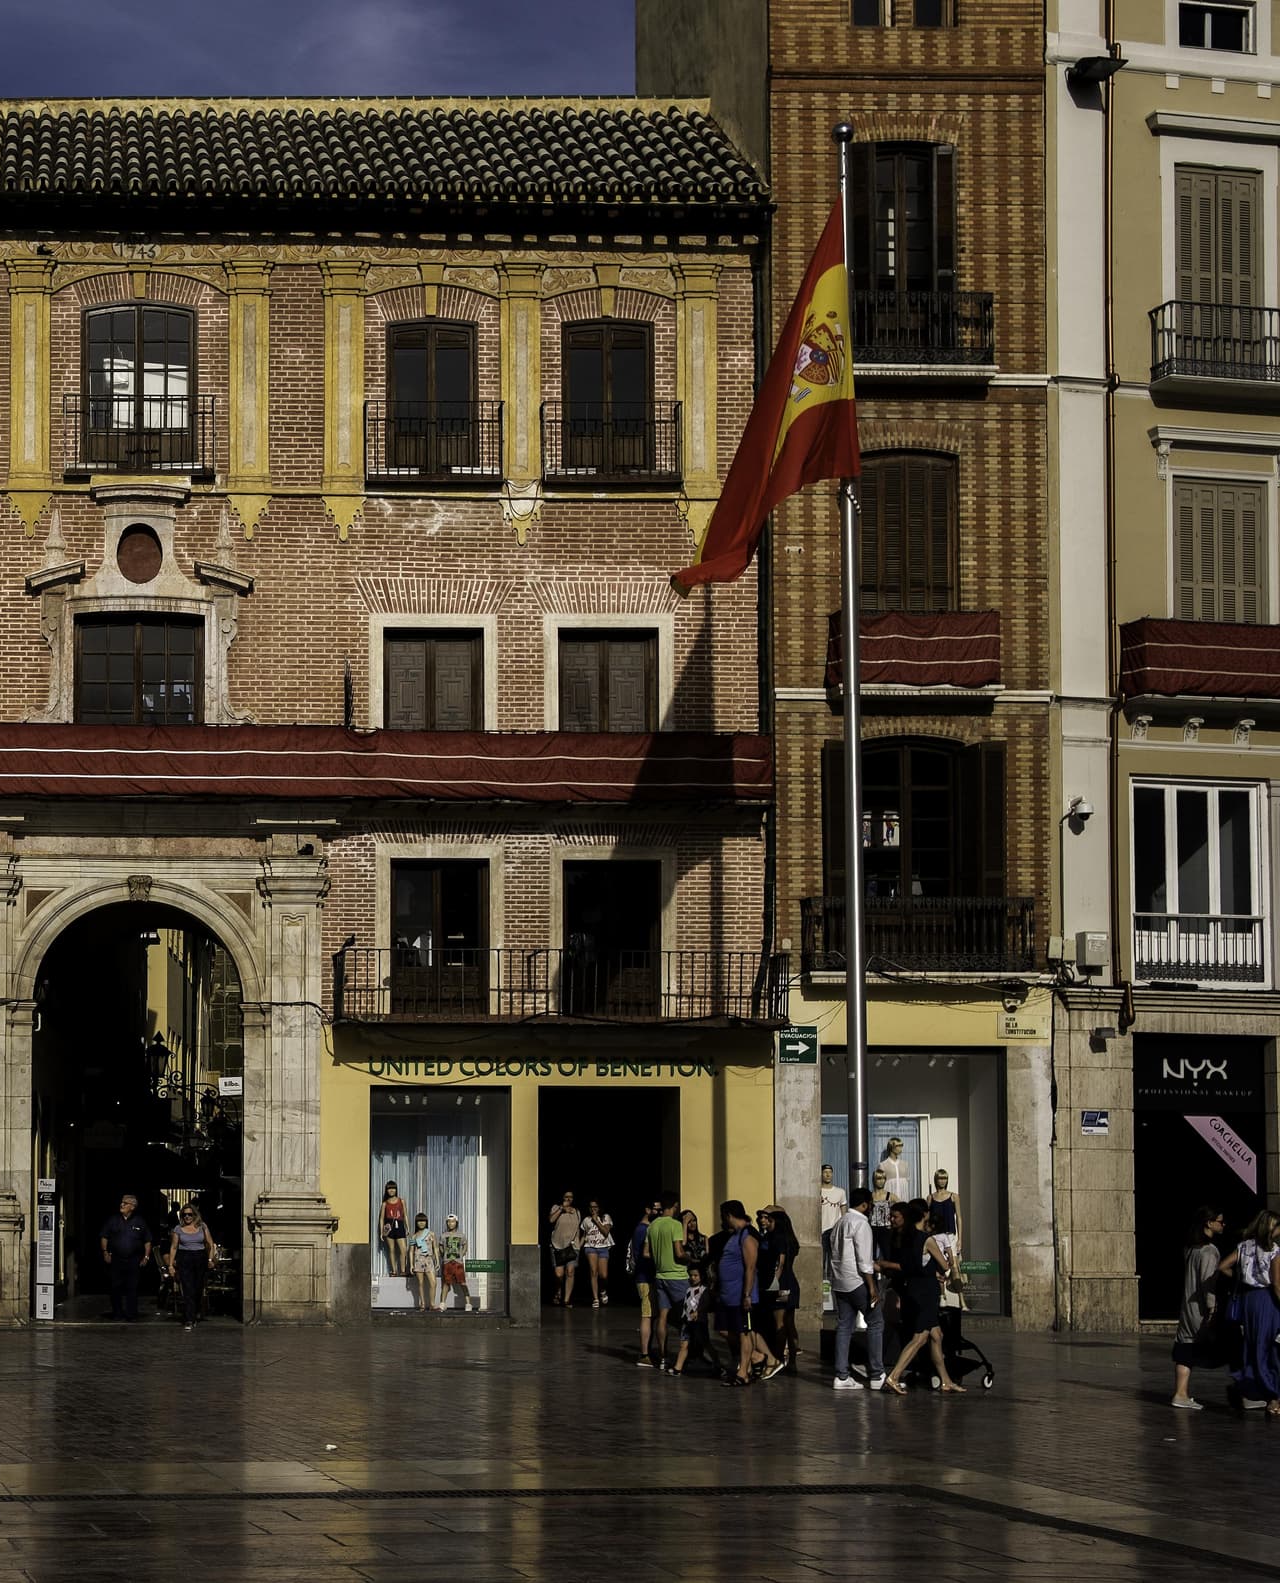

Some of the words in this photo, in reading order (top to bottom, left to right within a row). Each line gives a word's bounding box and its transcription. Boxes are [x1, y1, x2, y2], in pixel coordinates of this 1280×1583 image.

[368, 1056, 454, 1076] UNITED
[460, 1056, 552, 1077] COLORS
[558, 1056, 590, 1077] OF
[1162, 1057, 1228, 1080] NYX
[1209, 1118, 1253, 1166] COACHELLA
